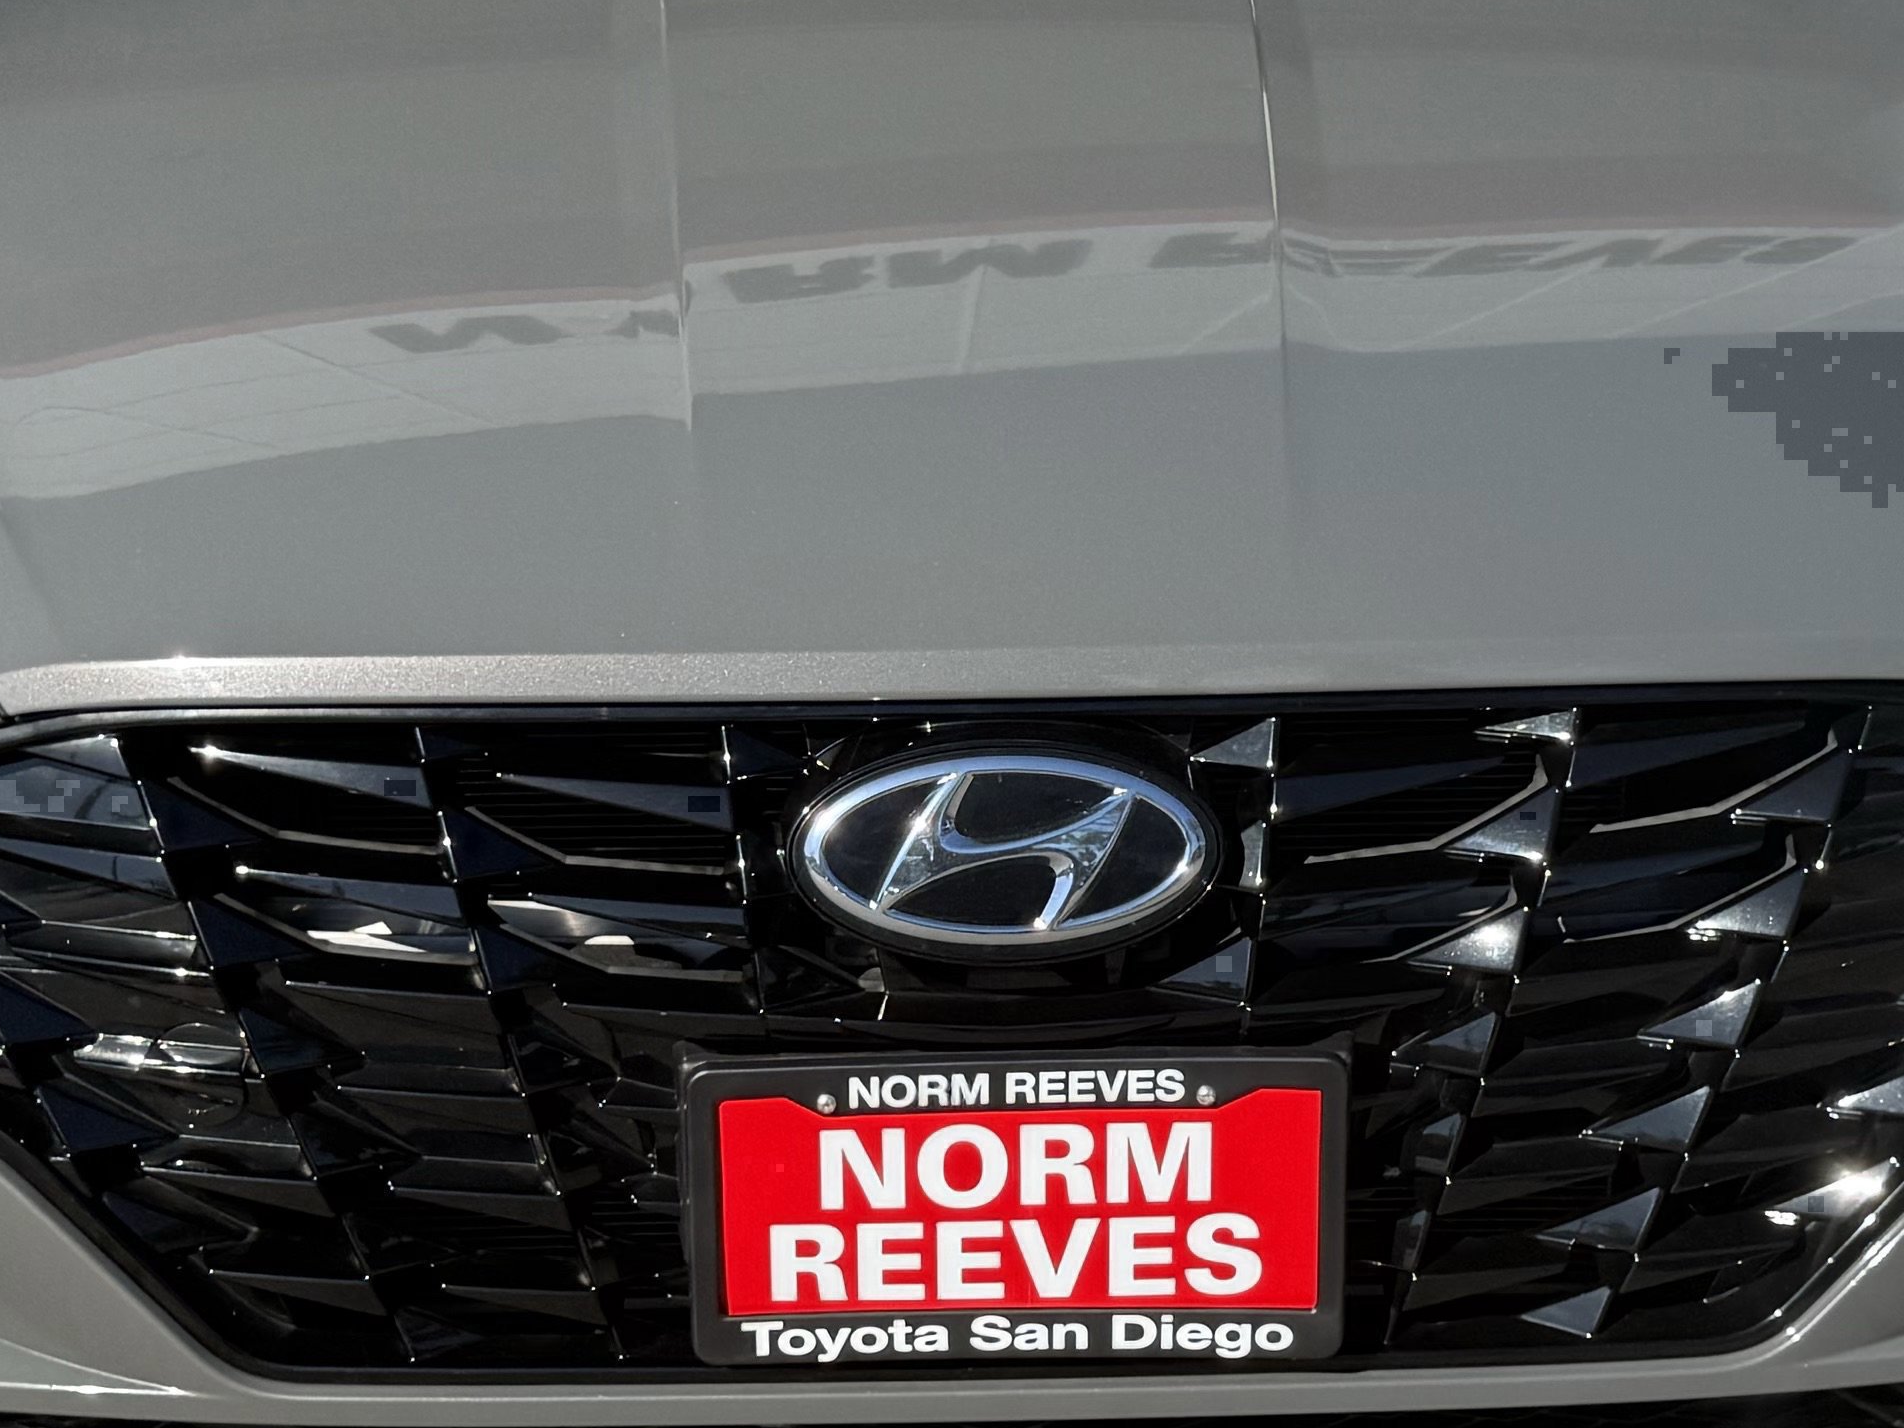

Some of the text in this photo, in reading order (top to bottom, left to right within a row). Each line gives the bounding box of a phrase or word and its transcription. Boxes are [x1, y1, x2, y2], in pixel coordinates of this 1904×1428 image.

[848, 1068, 1186, 1109] NORM REEVES
[819, 1121, 1213, 1211] NORM
[769, 1212, 1263, 1303] REEVES
[740, 1314, 1294, 1363] Toyota San Diego
